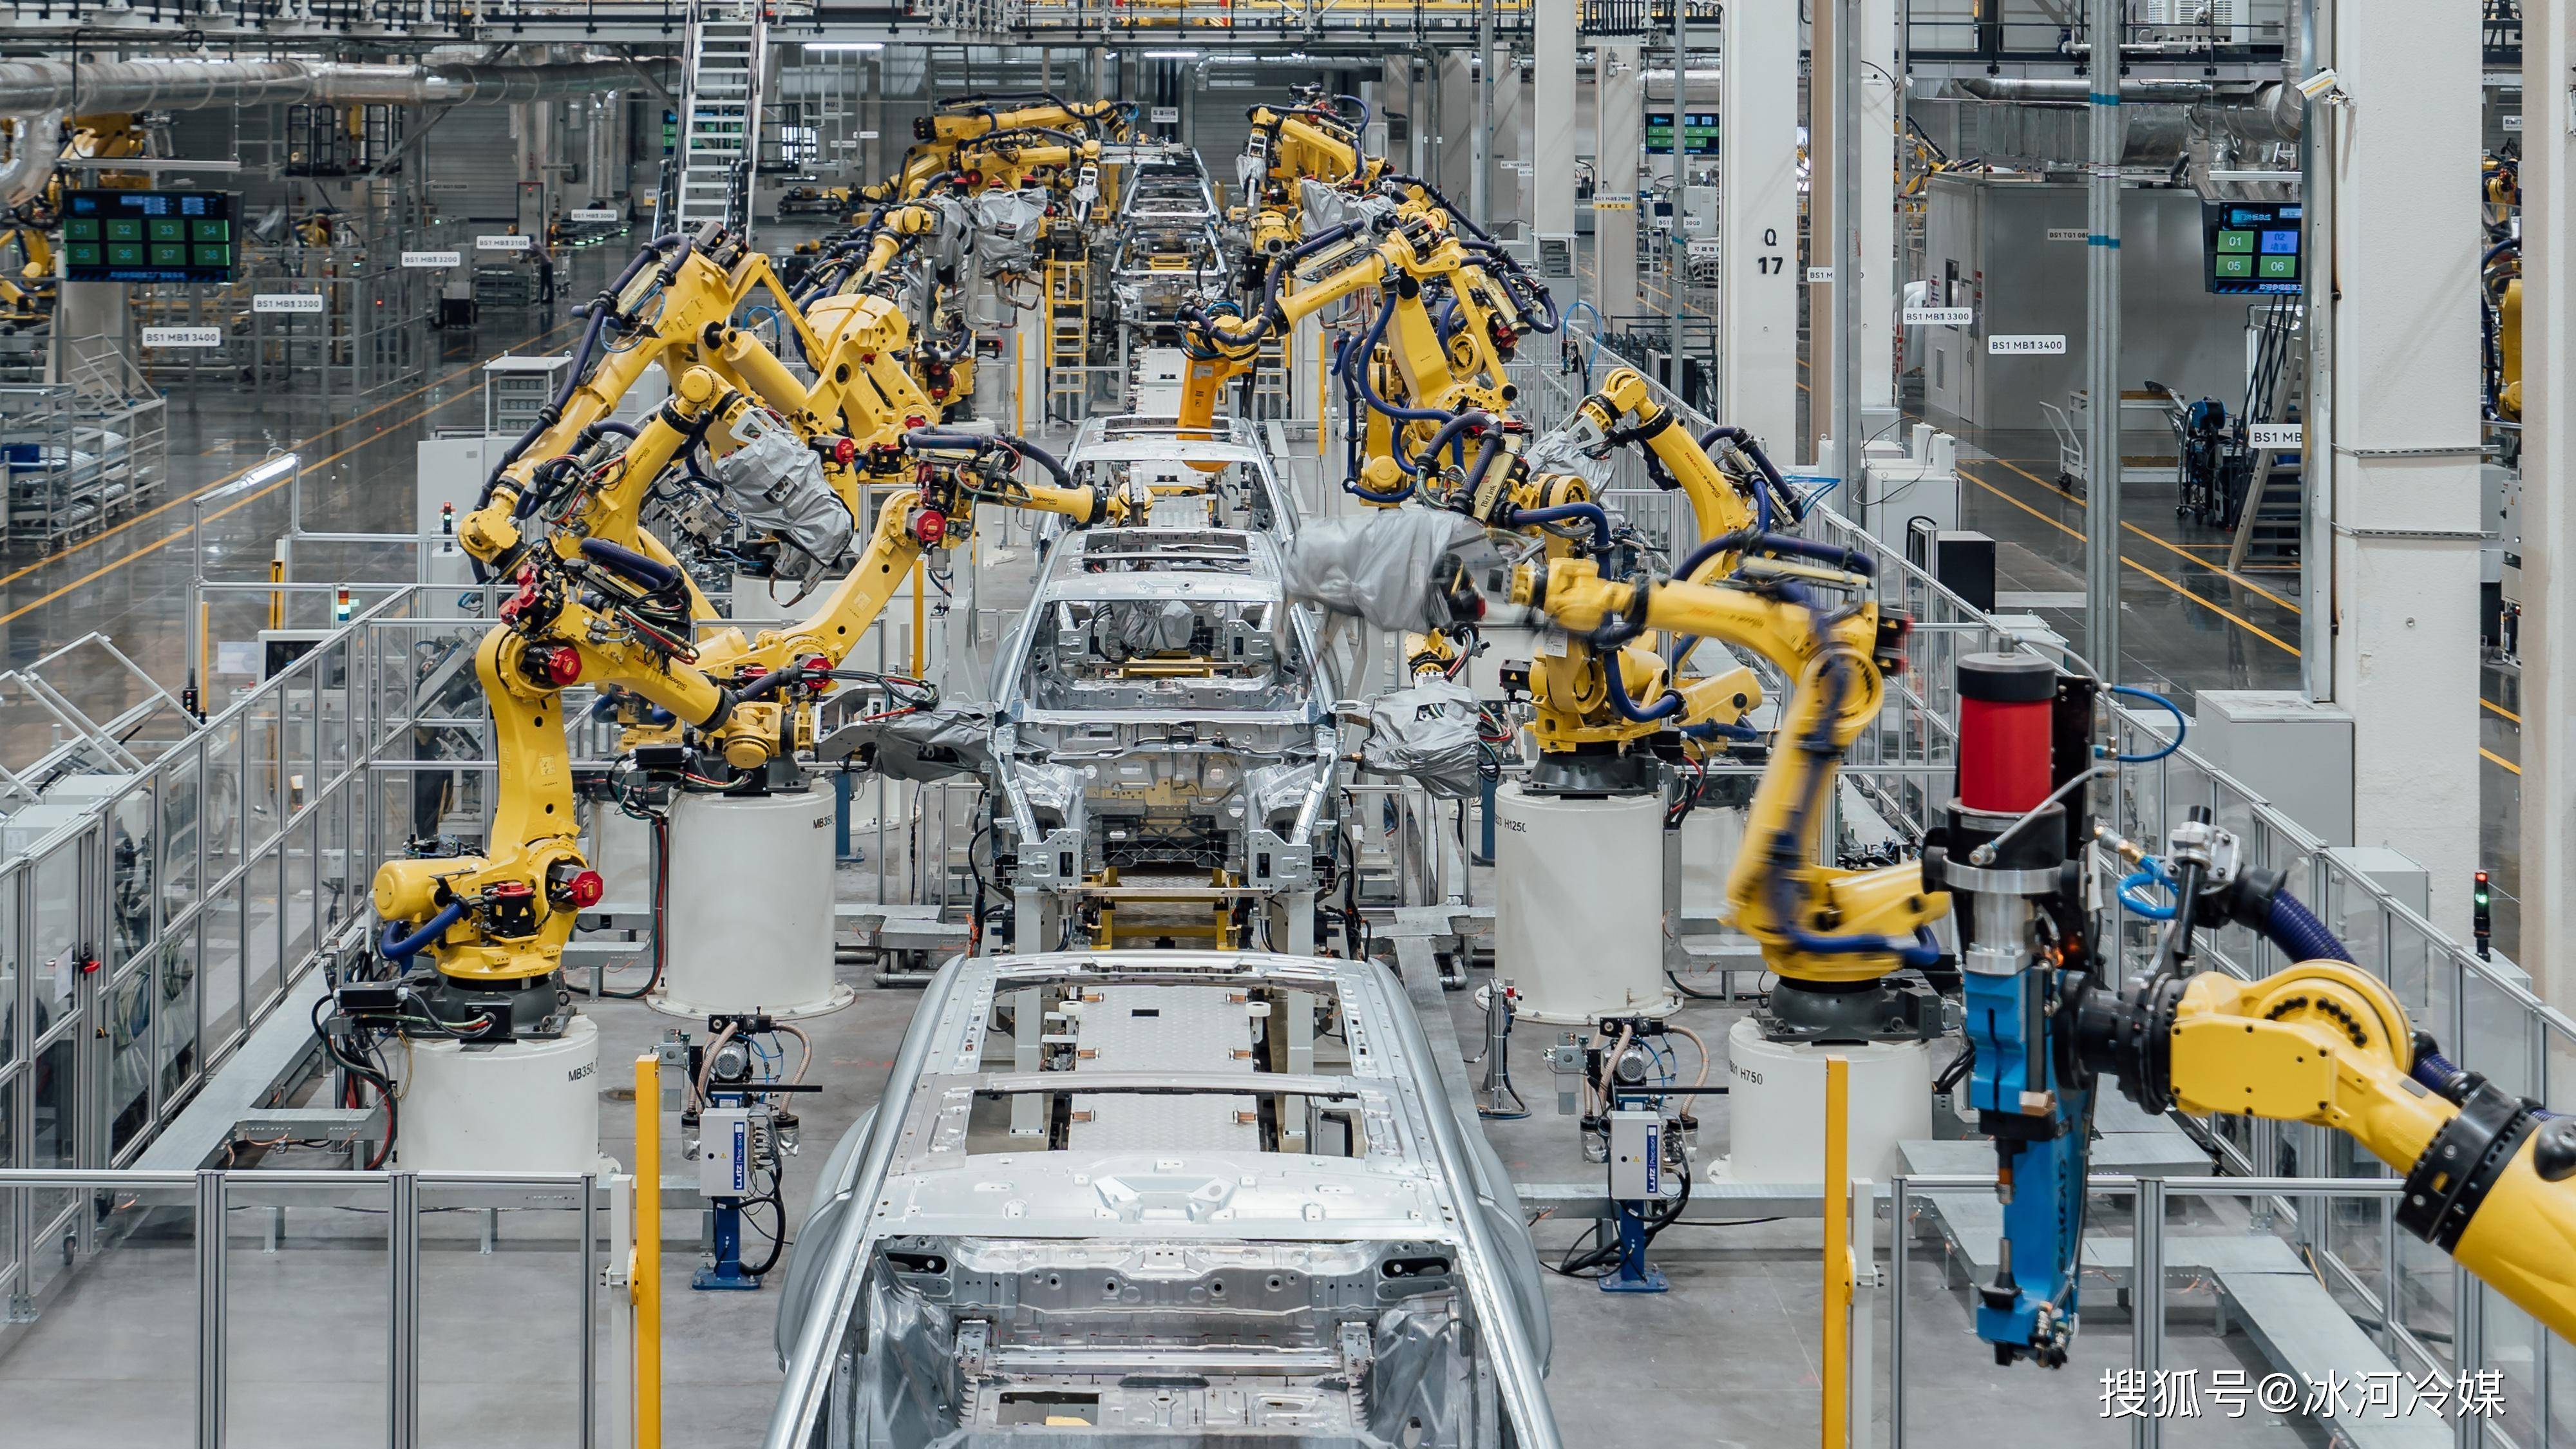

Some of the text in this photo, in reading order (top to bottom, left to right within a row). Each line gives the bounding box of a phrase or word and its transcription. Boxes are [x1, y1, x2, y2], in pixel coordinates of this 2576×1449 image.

[75, 225, 87, 234] 31
[117, 225, 131, 234] 32
[160, 225, 175, 235] 33
[204, 225, 216, 235] 34
[1764, 228, 1777, 246] Q
[2229, 236, 2242, 246] 01
[76, 249, 90, 258] 35
[118, 249, 133, 259] 36
[161, 249, 176, 259] 37
[1757, 256, 1783, 274] 17
[2227, 261, 2241, 270] 05
[2271, 261, 2285, 271] 06
[256, 299, 319, 308] BS1 MB1 3300
[1992, 341, 2062, 350] BS1 MB1 3400
[2254, 432, 2302, 442] BS1 MB
[1741, 1067, 1763, 1085] H750
